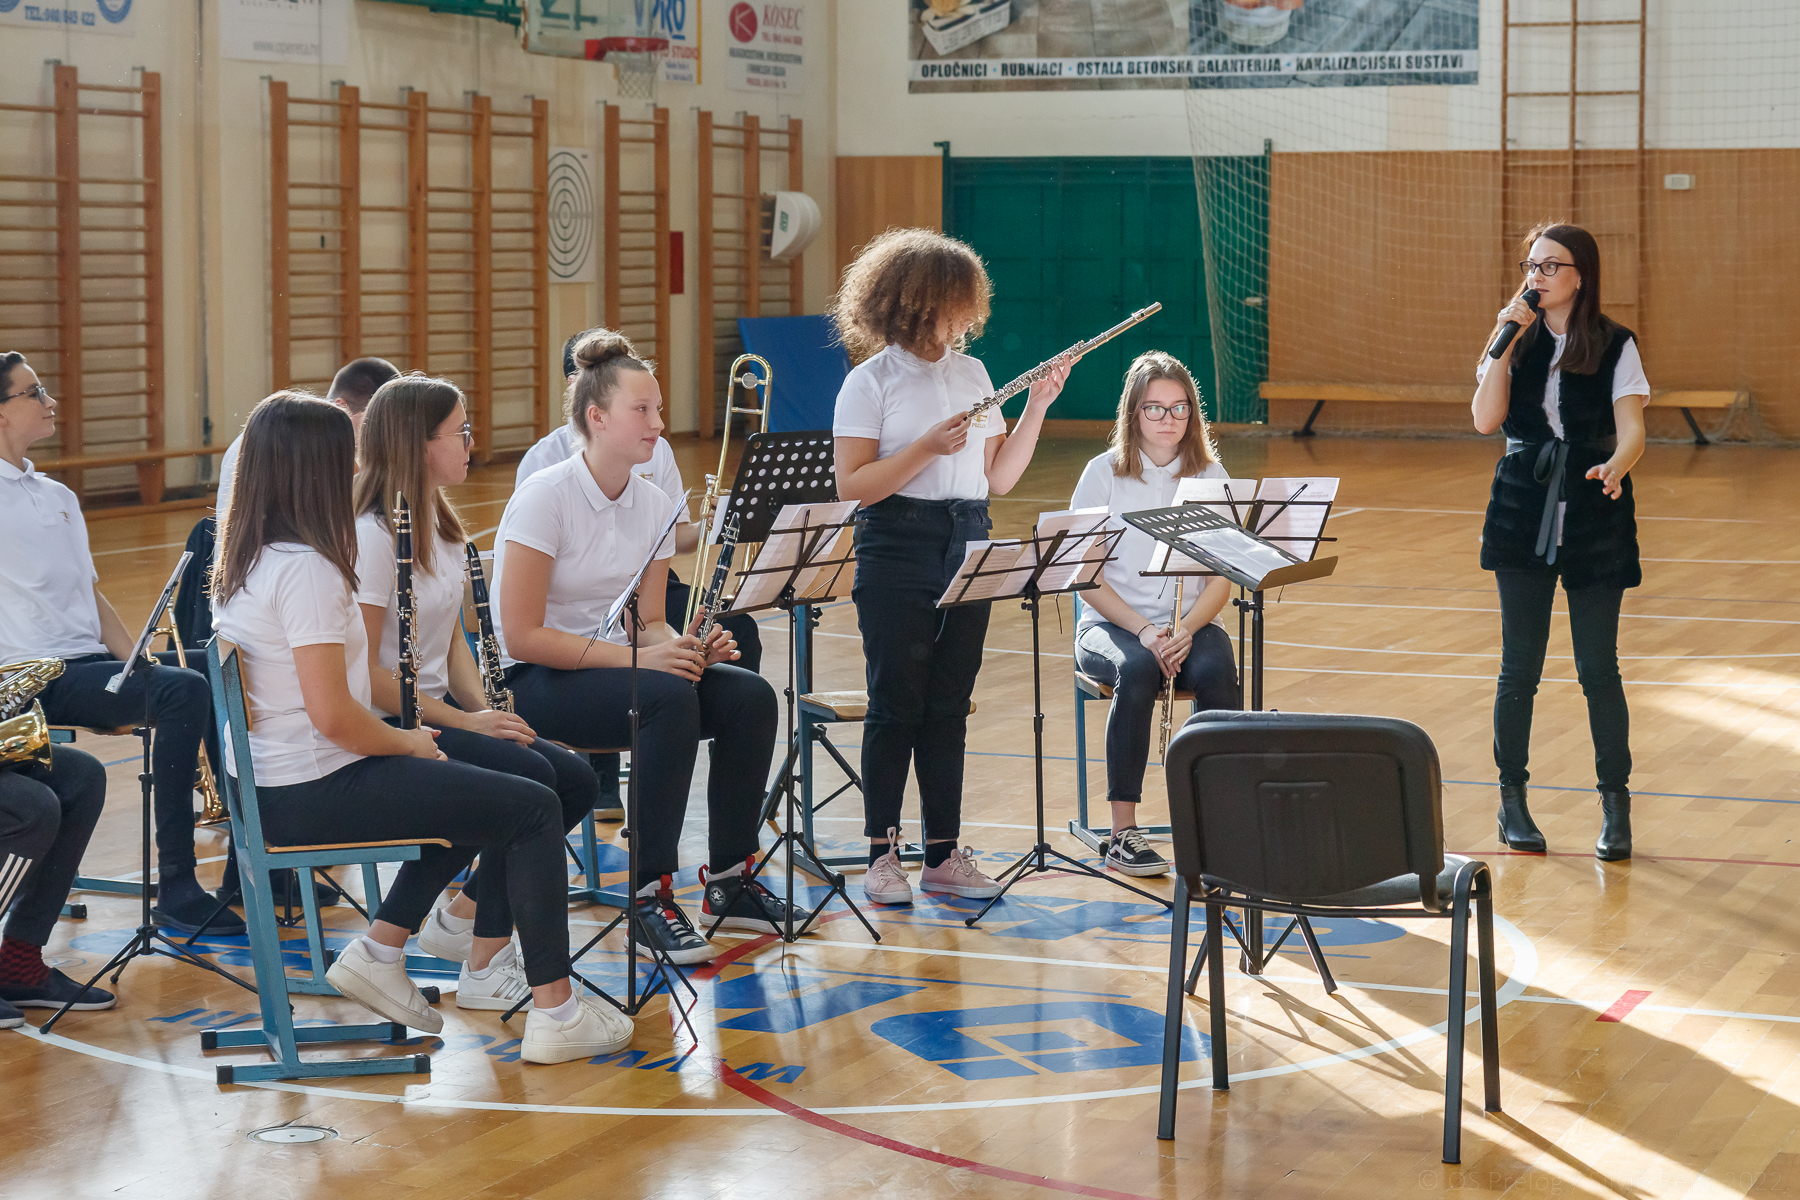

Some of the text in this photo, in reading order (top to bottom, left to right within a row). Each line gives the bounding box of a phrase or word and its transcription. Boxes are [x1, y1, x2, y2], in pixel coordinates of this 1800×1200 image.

[762, 4, 804, 31] KOSEC
[921, 53, 1464, 78] OPLOČNICI RUBNJACI OSTALA BETONSKA GALANTERIJA KANALIZACIJSKI SUSTAVI
